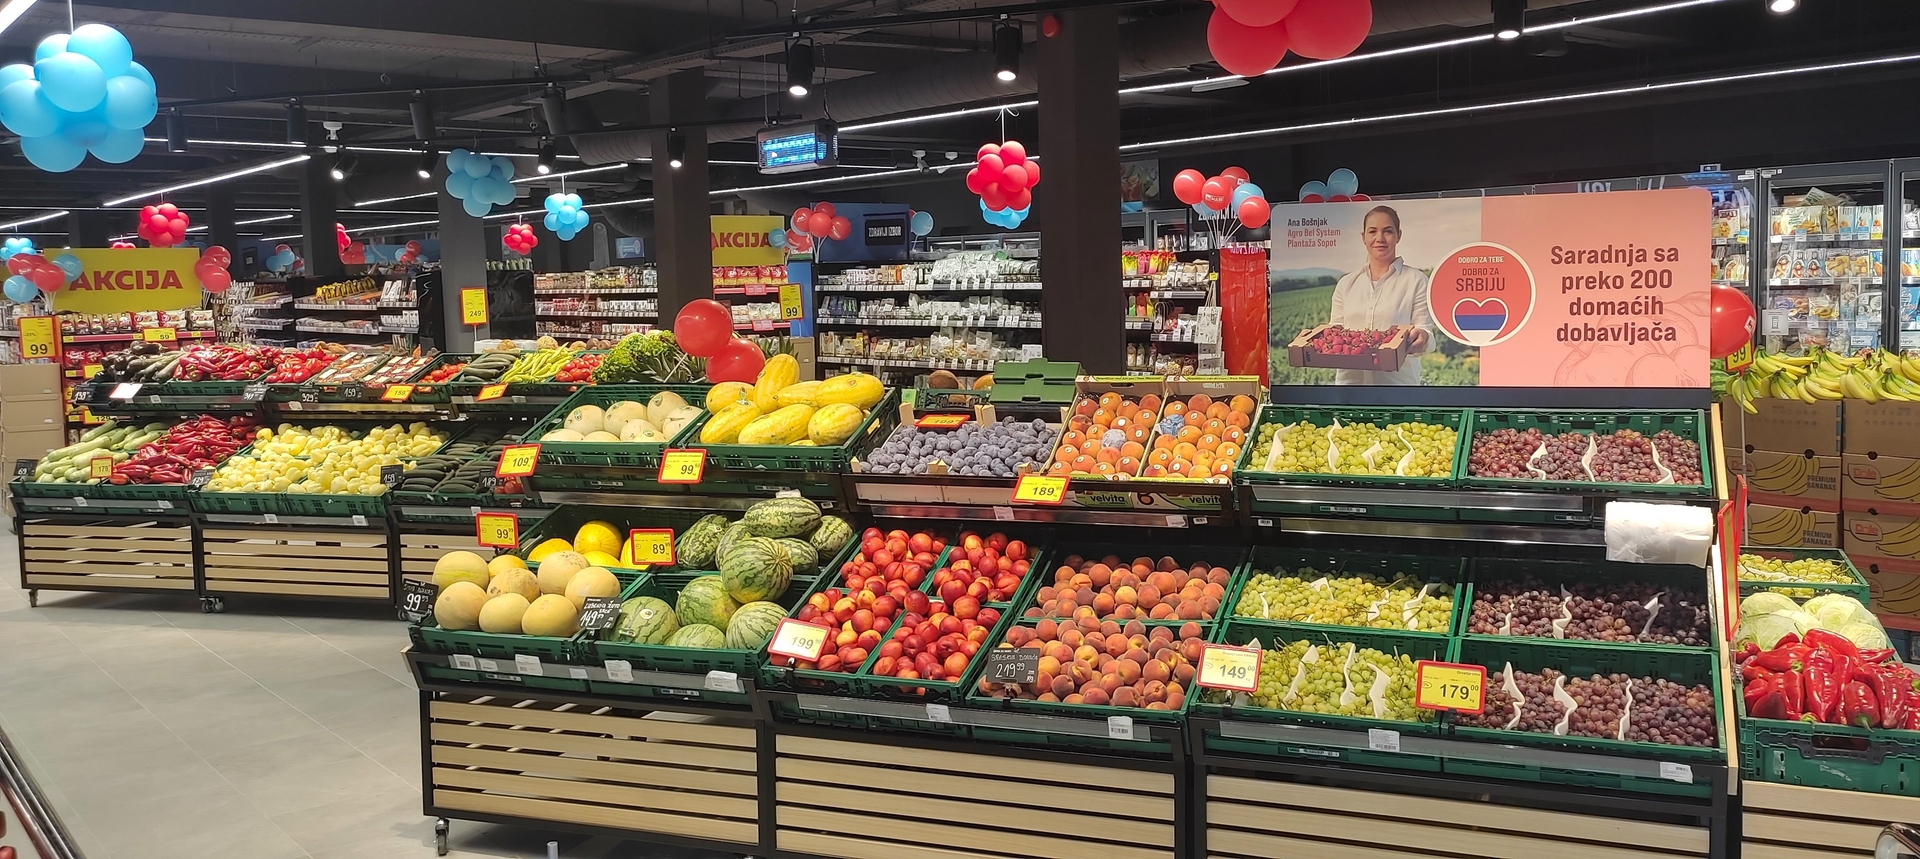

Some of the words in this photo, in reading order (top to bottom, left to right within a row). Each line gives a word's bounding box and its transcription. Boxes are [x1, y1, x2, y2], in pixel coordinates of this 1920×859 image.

[1287, 218, 1300, 227] Ana
[1301, 217, 1328, 227] Bošnjak
[1287, 229, 1303, 238] Agro
[1316, 228, 1341, 238] System
[1287, 239, 1316, 247] Plantaža
[1317, 239, 1337, 248] Sopot
[1458, 256, 1478, 264] DOBRO
[1550, 244, 1648, 269] Saradnja
[1654, 246, 1679, 263] sa
[1462, 267, 1488, 276] DOBRO
[1489, 267, 1499, 275] ZA
[69, 270, 183, 291] AKCIJA
[1455, 277, 1505, 292] SRBIJU
[1561, 270, 1625, 295] preko
[1630, 269, 1673, 290] 200
[1568, 296, 1664, 316] domaćih
[786, 307, 798, 317] 99
[1555, 321, 1678, 346] dobavljača
[30, 344, 48, 355] 99
[512, 457, 529, 468] 109
[680, 464, 694, 475] 99
[1853, 467, 1877, 479] Dole
[1807, 474, 1837, 484] PREMIUM
[1033, 486, 1055, 496] 189
[1807, 482, 1837, 491] BANANAS
[1090, 494, 1125, 502] velvita
[496, 528, 509, 539] 99
[1802, 529, 1832, 539] PREMIUM
[1854, 523, 1879, 534] Dole
[1802, 537, 1833, 546] BANANAS
[652, 543, 665, 555] 89
[403, 593, 421, 611] 99
[791, 636, 814, 650] 199
[995, 662, 1016, 678] 219
[1219, 664, 1247, 680] 149
[1439, 683, 1470, 700] 179
[1470, 684, 1480, 692] 00
